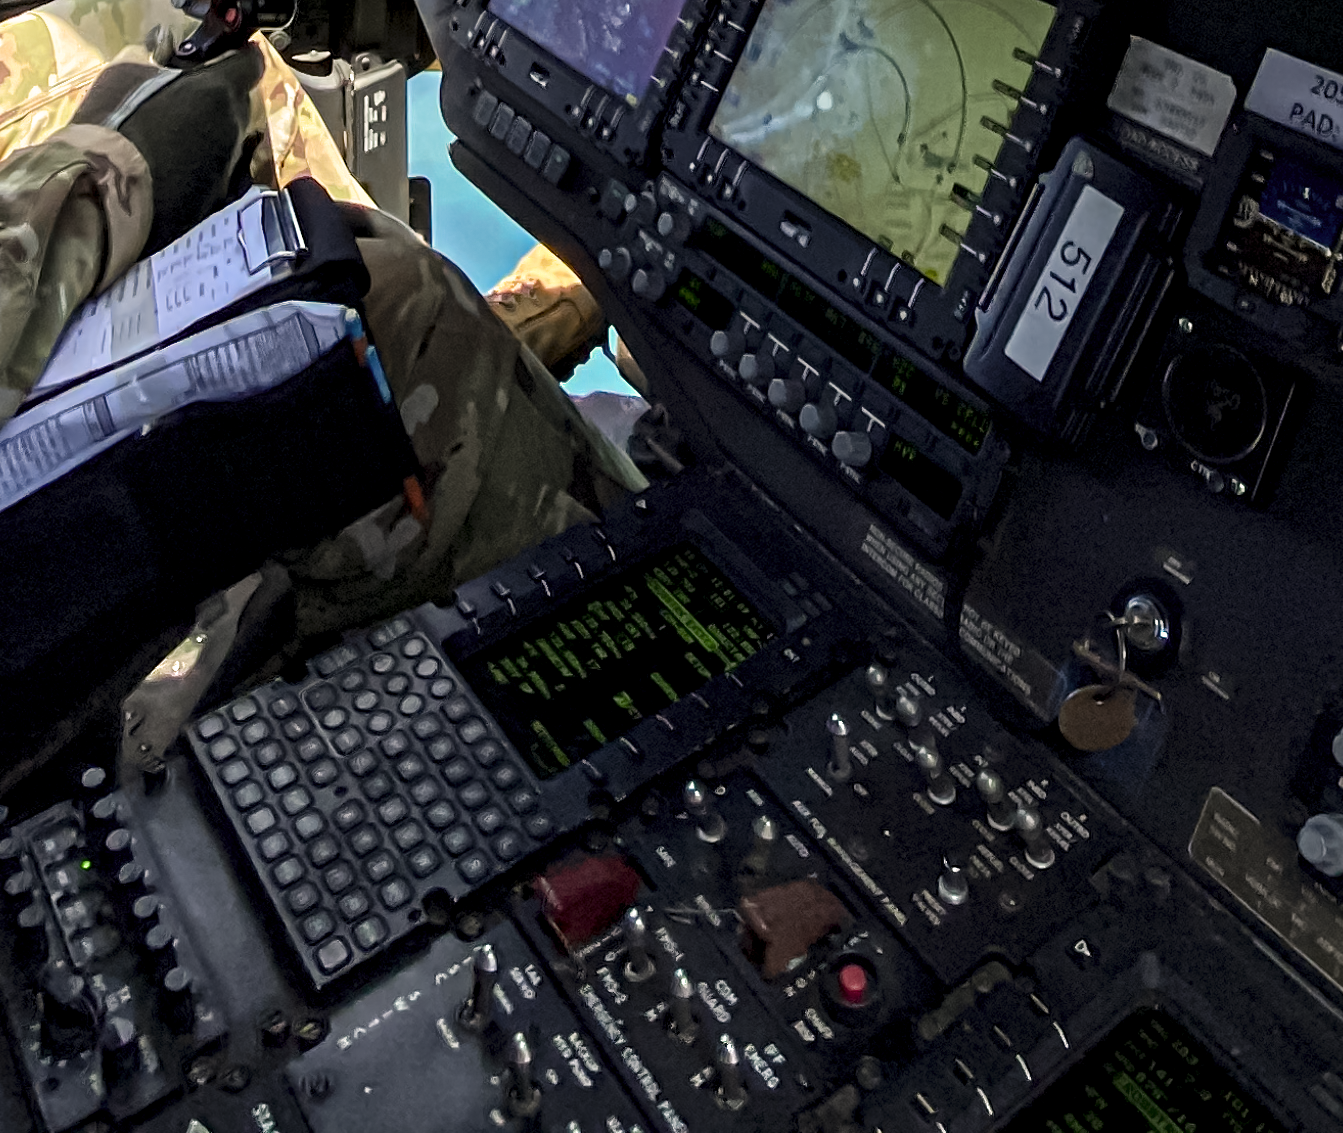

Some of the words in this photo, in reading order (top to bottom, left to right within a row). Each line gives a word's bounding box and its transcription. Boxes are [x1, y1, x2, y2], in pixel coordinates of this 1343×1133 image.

[1289, 102, 1340, 141] PAD:
[1034, 239, 1092, 324] 512
[697, 981, 732, 1024] GUARD
[744, 1042, 781, 1090] EMERG
